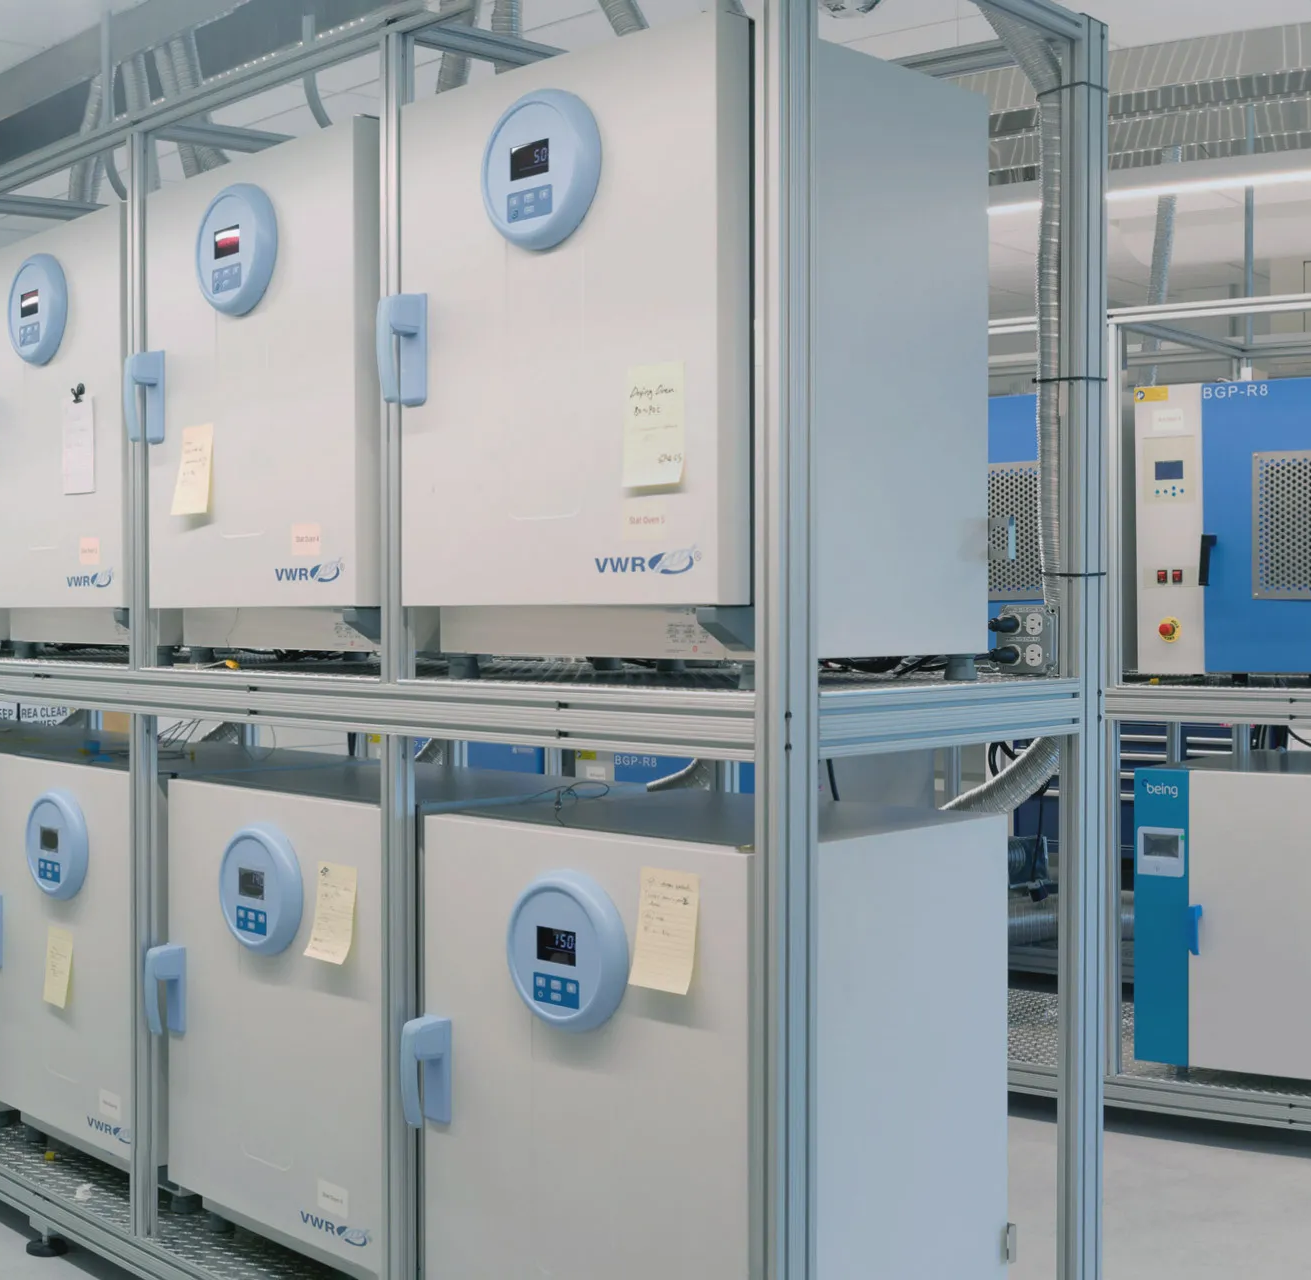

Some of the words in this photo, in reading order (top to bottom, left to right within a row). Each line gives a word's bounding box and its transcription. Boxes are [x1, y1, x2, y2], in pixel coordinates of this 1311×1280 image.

[1203, 384, 1268, 399] BGP-R8
[595, 557, 646, 573] VWR
[67, 575, 90, 587] VWR
[275, 568, 308, 581] VWR
[40, 706, 68, 718] CLEAR
[615, 754, 657, 768] BGP-R8
[1146, 783, 1178, 798] being
[87, 1115, 112, 1136] VWR
[300, 1210, 335, 1236] VWR
